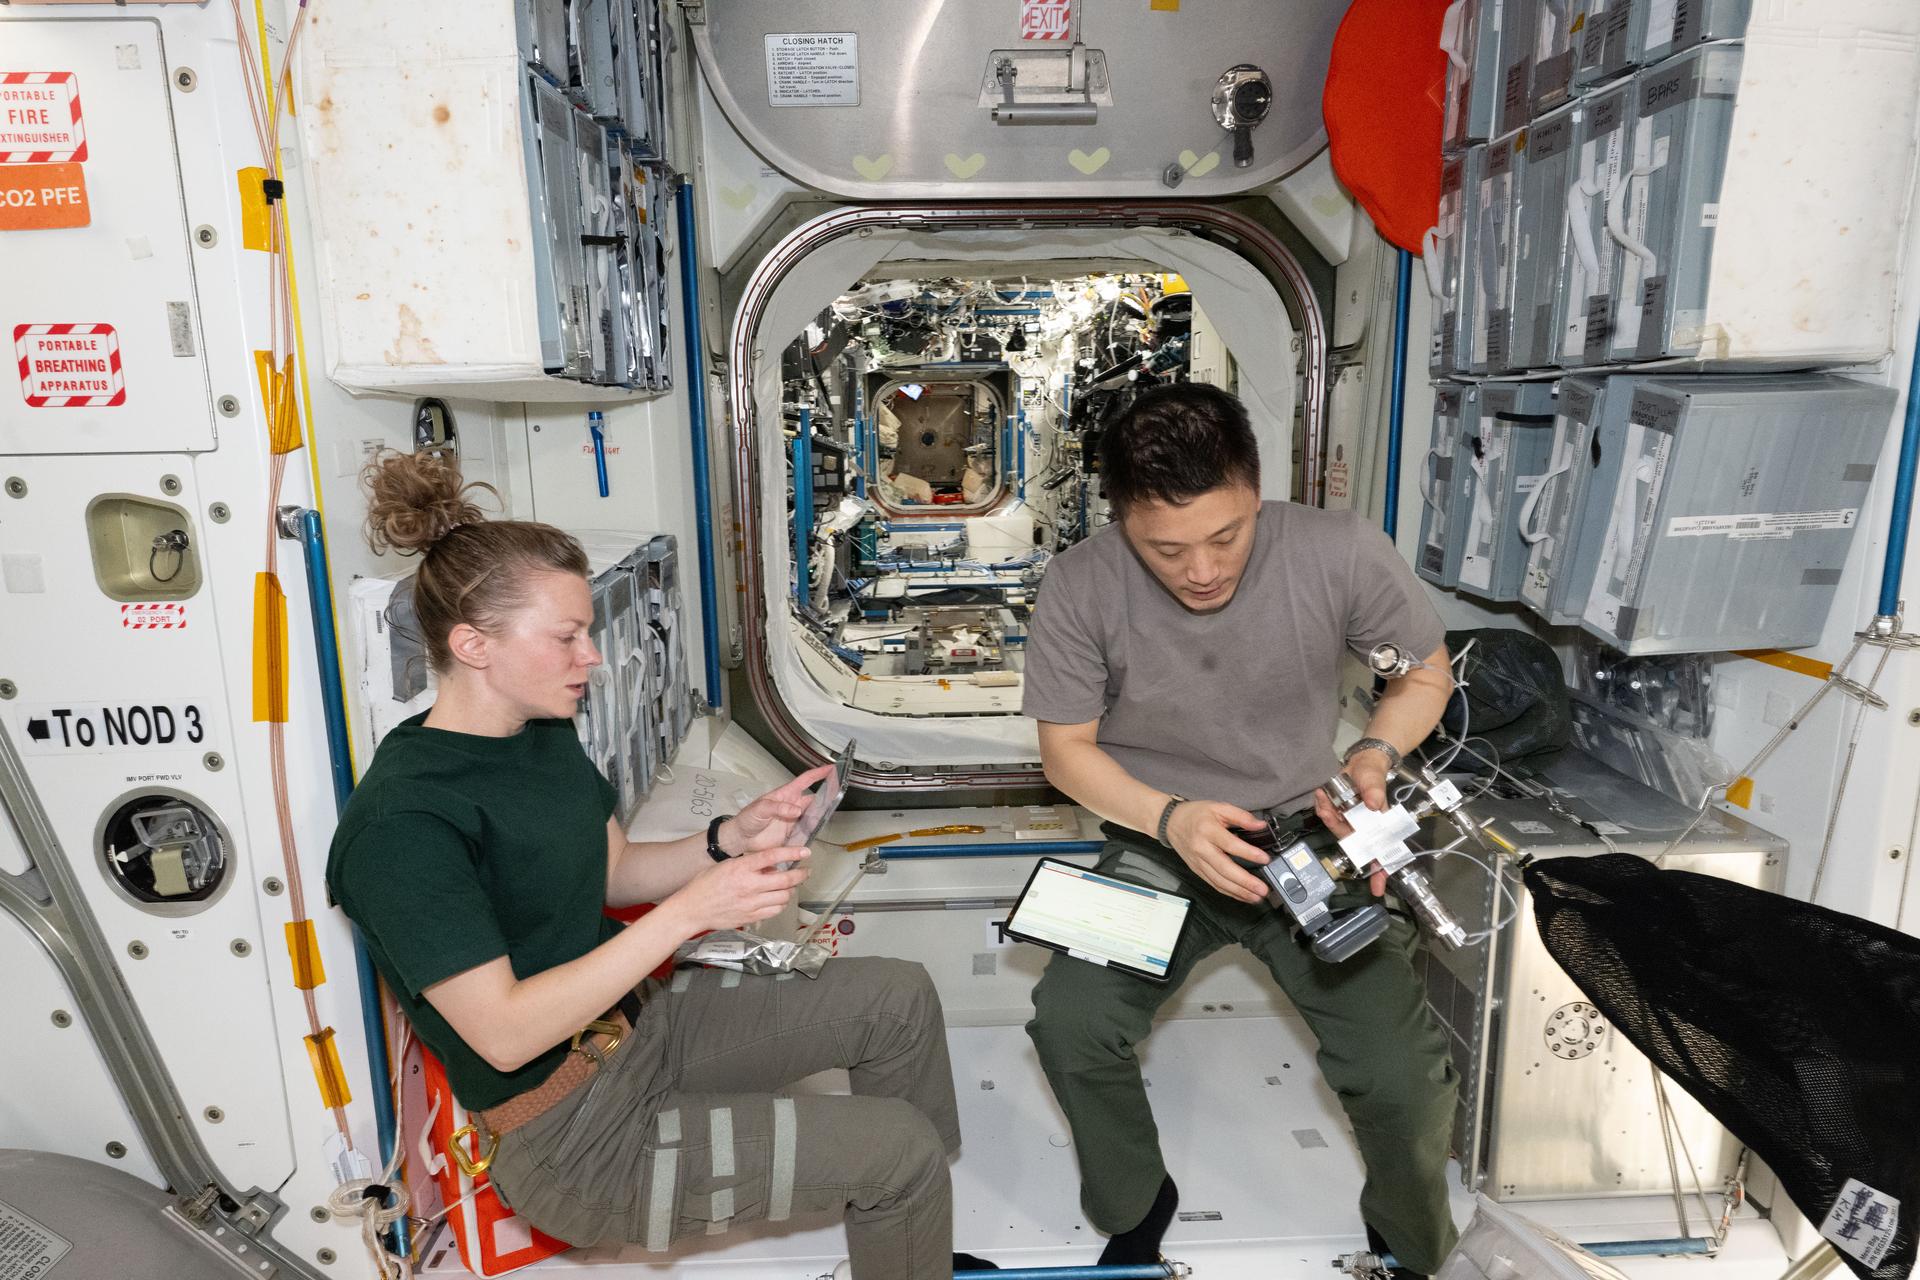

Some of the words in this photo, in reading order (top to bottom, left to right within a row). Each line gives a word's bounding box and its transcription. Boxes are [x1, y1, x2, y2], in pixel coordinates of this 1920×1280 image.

[1030, 7, 1063, 29] EXIT
[817, 37, 844, 45] HATCH
[0, 90, 55, 101] ORTABLE
[1647, 78, 1680, 108] BARS
[8, 109, 50, 125] FIRE
[41, 187, 82, 207] PFE
[38, 340, 97, 351] PORTABLE
[35, 359, 107, 373] BREATHING
[40, 380, 108, 391] APPARATUS
[150, 615, 170, 623] PORT
[51, 709, 97, 748] To
[102, 705, 177, 747] NOD
[184, 704, 204, 744] 3
[10, 1264, 26, 1278] LATCH
[20, 1256, 51, 1280] CLOSI
